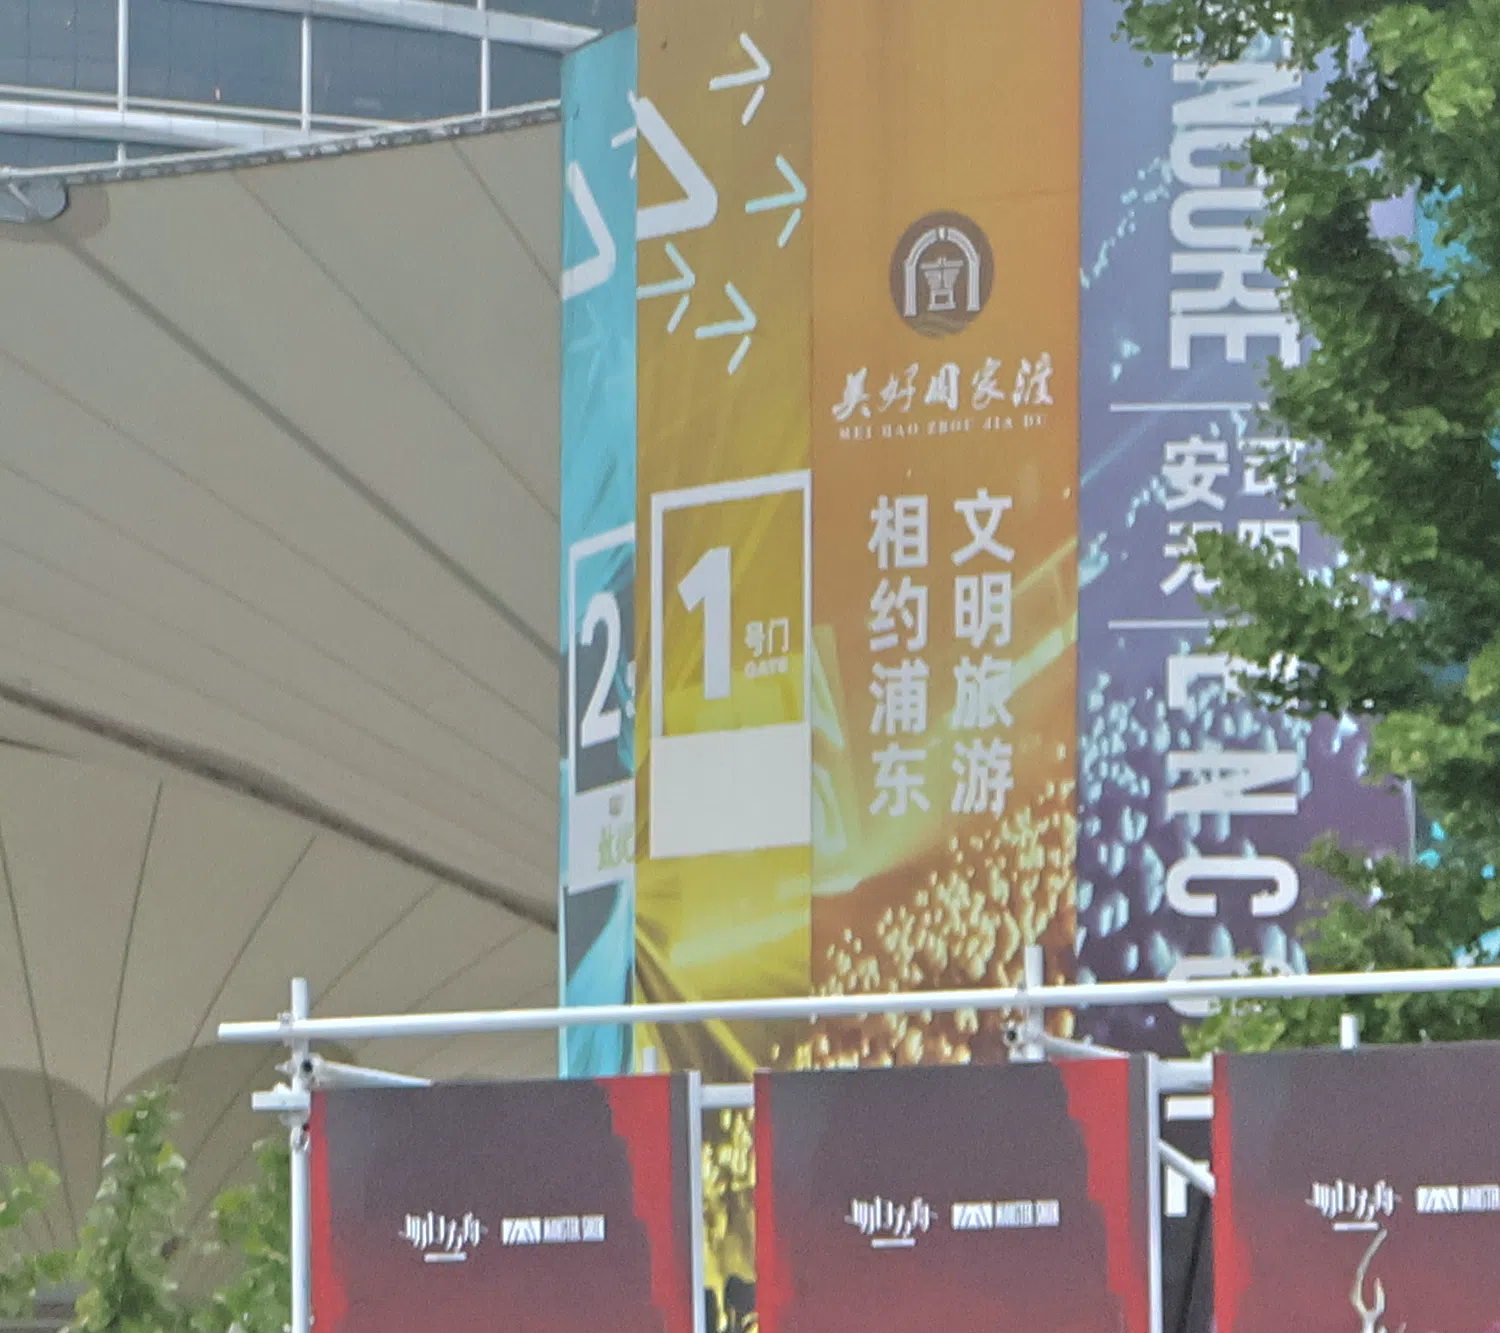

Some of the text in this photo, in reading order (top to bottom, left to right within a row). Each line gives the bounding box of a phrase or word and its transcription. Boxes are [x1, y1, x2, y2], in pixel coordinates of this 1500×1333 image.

[581, 576, 622, 748] 2
[677, 546, 731, 700] 1
[868, 494, 931, 817] 相约浦东
[951, 487, 1015, 819] 文明旅游
